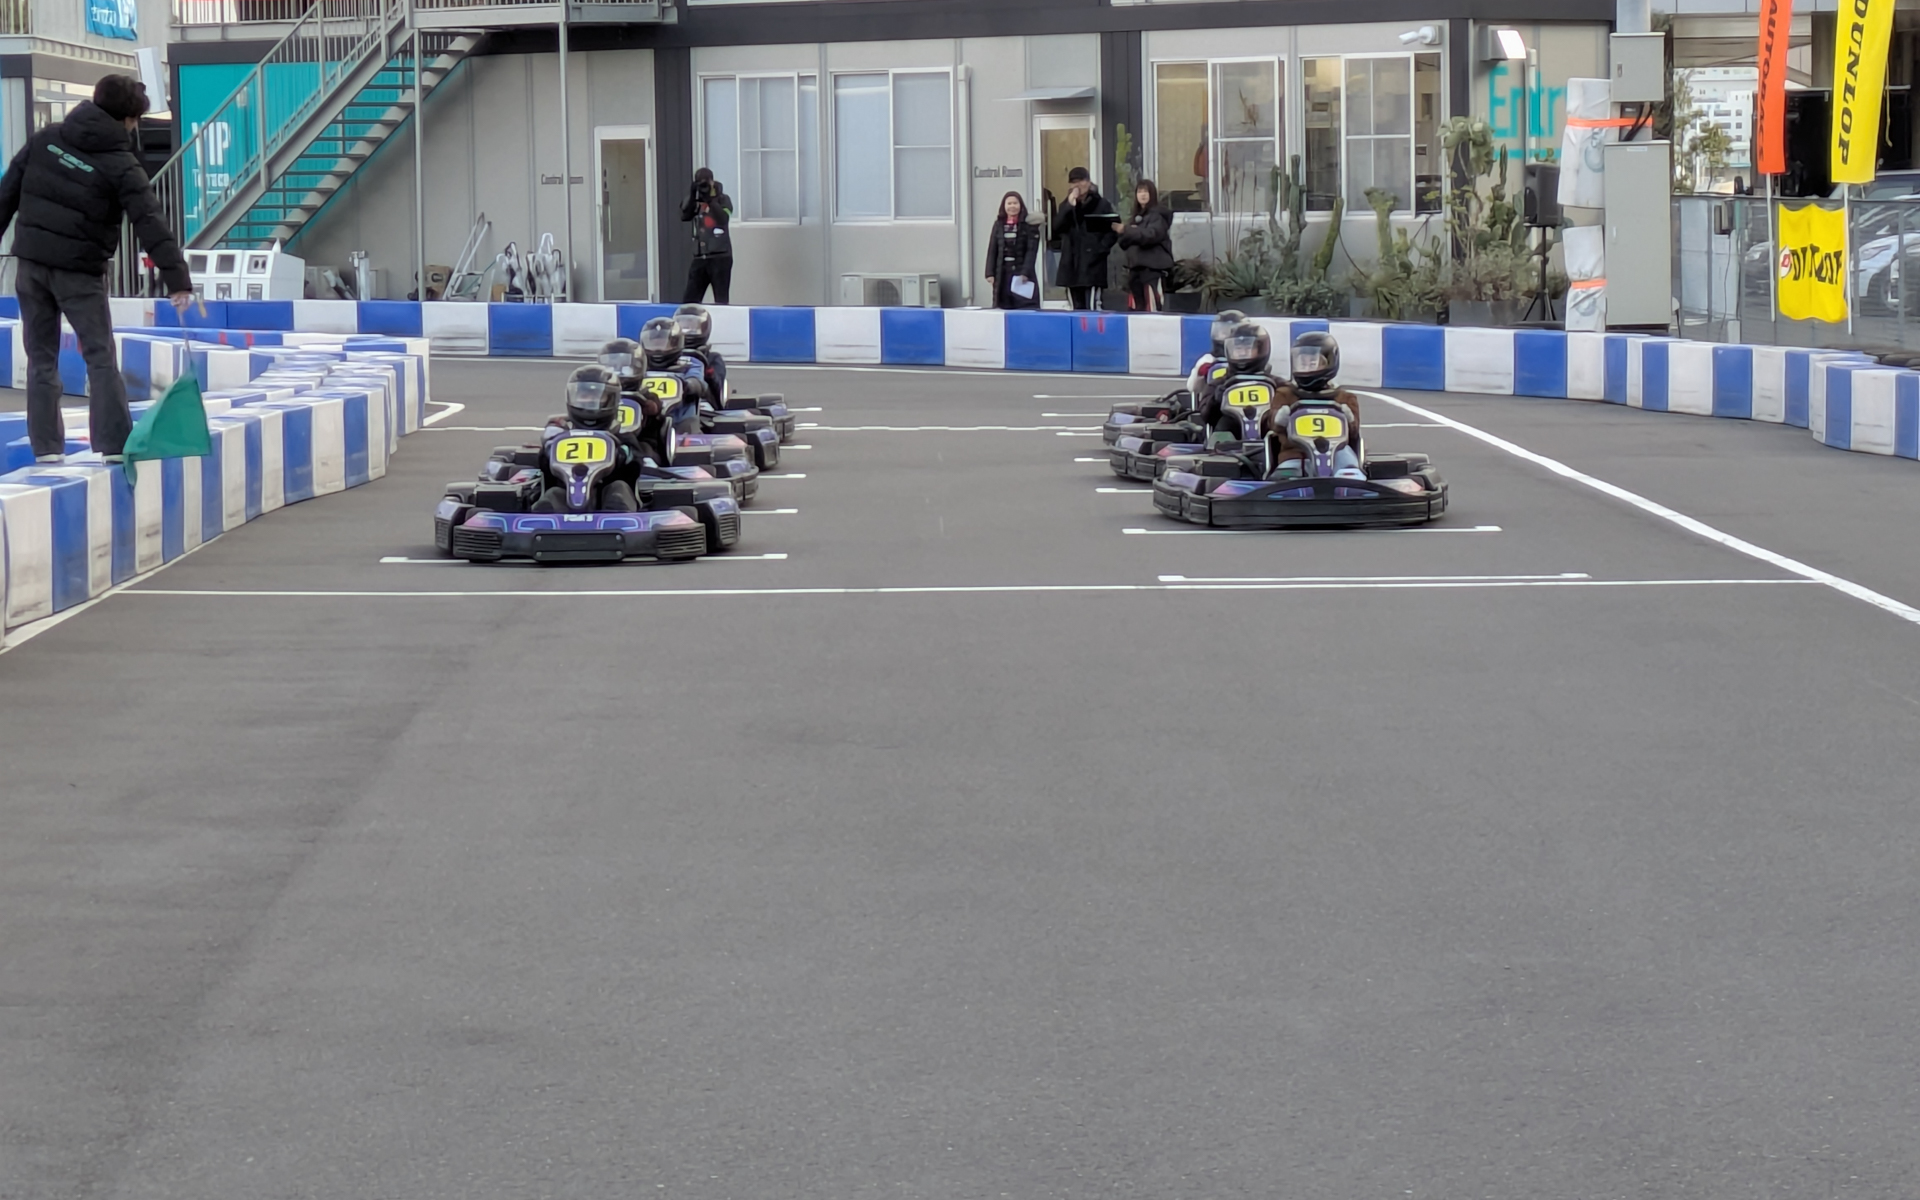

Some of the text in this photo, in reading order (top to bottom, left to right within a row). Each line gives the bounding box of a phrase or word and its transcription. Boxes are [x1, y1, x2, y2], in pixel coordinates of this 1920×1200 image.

[1838, 0, 1869, 165] DUNLOP
[1488, 65, 1567, 138] Entr
[191, 121, 231, 166] VIP
[1239, 389, 1259, 403] 16
[1312, 418, 1326, 433] 9
[566, 442, 593, 460] 21
